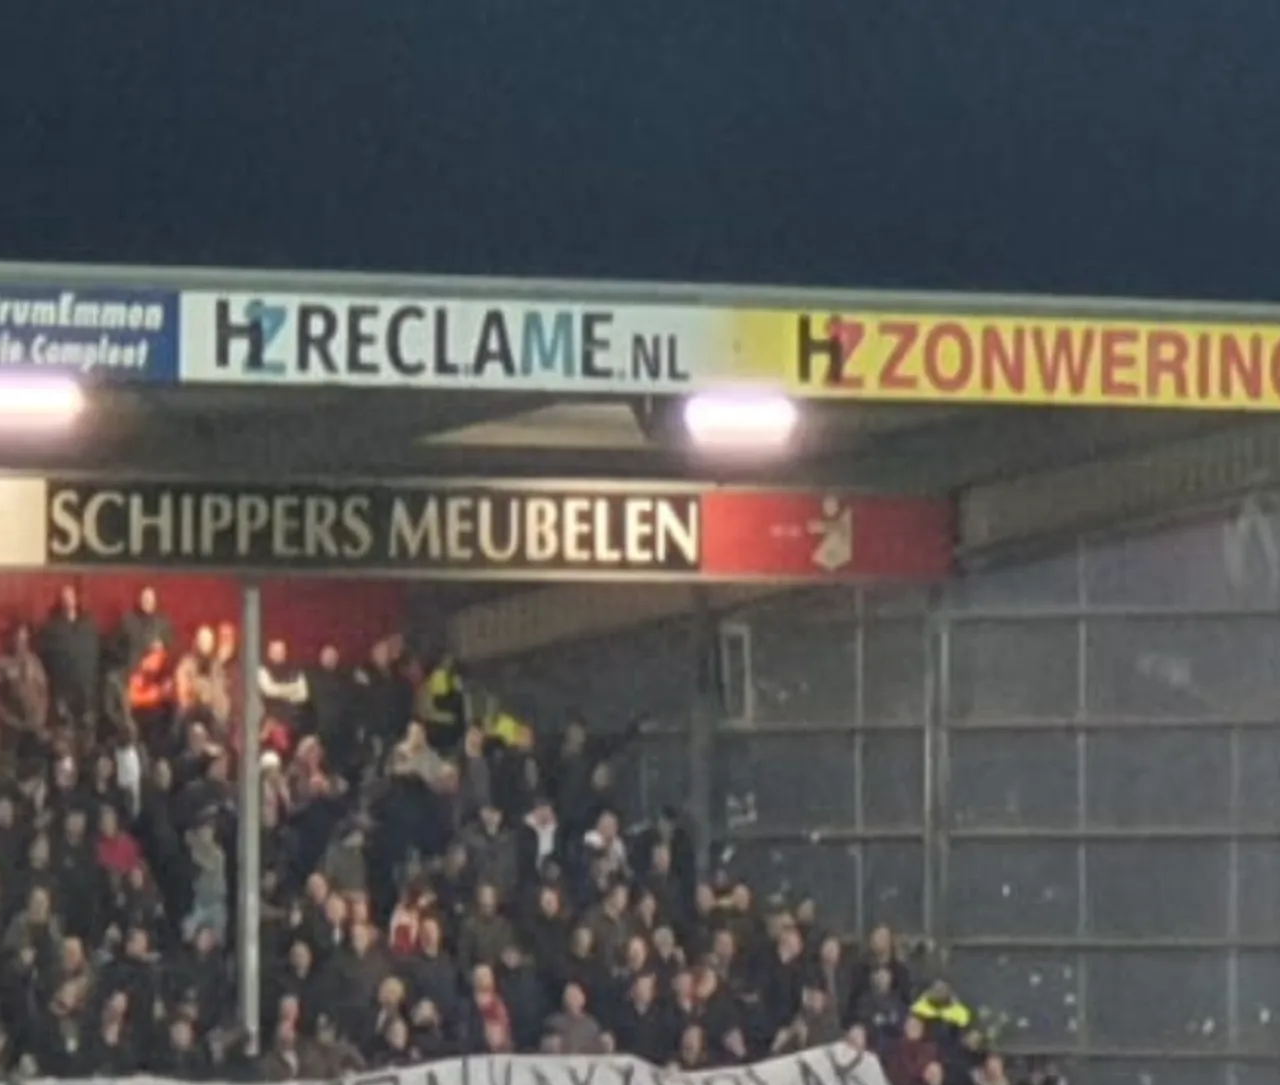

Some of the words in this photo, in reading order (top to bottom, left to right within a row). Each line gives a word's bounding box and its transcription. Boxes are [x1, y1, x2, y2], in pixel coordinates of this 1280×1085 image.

[297, 303, 690, 382] RECLAME.NL
[50, 487, 373, 560] SCHIPPERS
[387, 494, 700, 564] MEUBELEN
